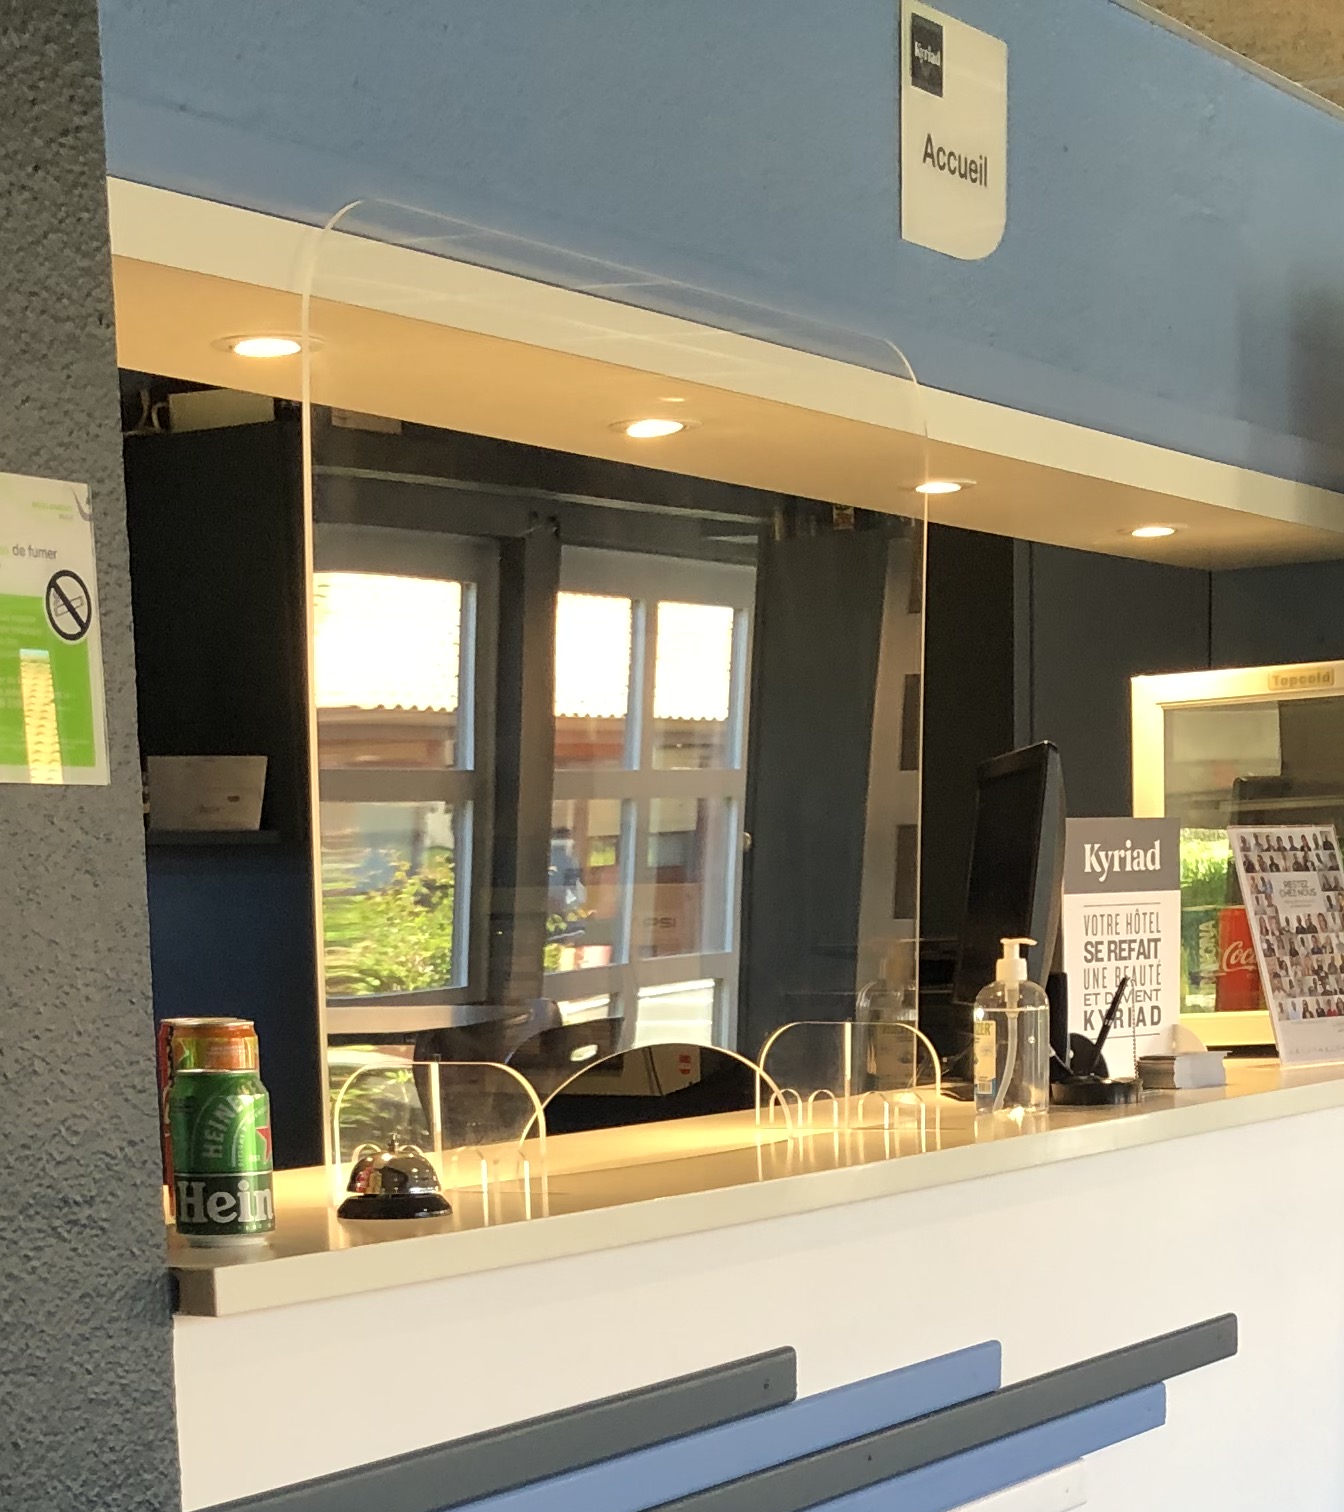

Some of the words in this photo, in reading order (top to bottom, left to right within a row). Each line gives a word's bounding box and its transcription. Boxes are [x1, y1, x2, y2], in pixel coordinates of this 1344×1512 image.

[922, 133, 988, 188] Accueil
[12, 544, 26, 556] de
[28, 545, 57, 559] fumer
[1272, 671, 1330, 688] Topcold
[1084, 839, 1161, 883] Kyriad
[1084, 913, 1120, 936] VOTRE
[1126, 908, 1161, 935] HÔTEL
[1084, 940, 1104, 963] SE
[1107, 938, 1161, 962] REFAIT
[1084, 967, 1107, 990] UNE
[1084, 993, 1101, 1006] ET
[1105, 989, 1161, 1005] DVIENT
[177, 1179, 274, 1223] Hein
